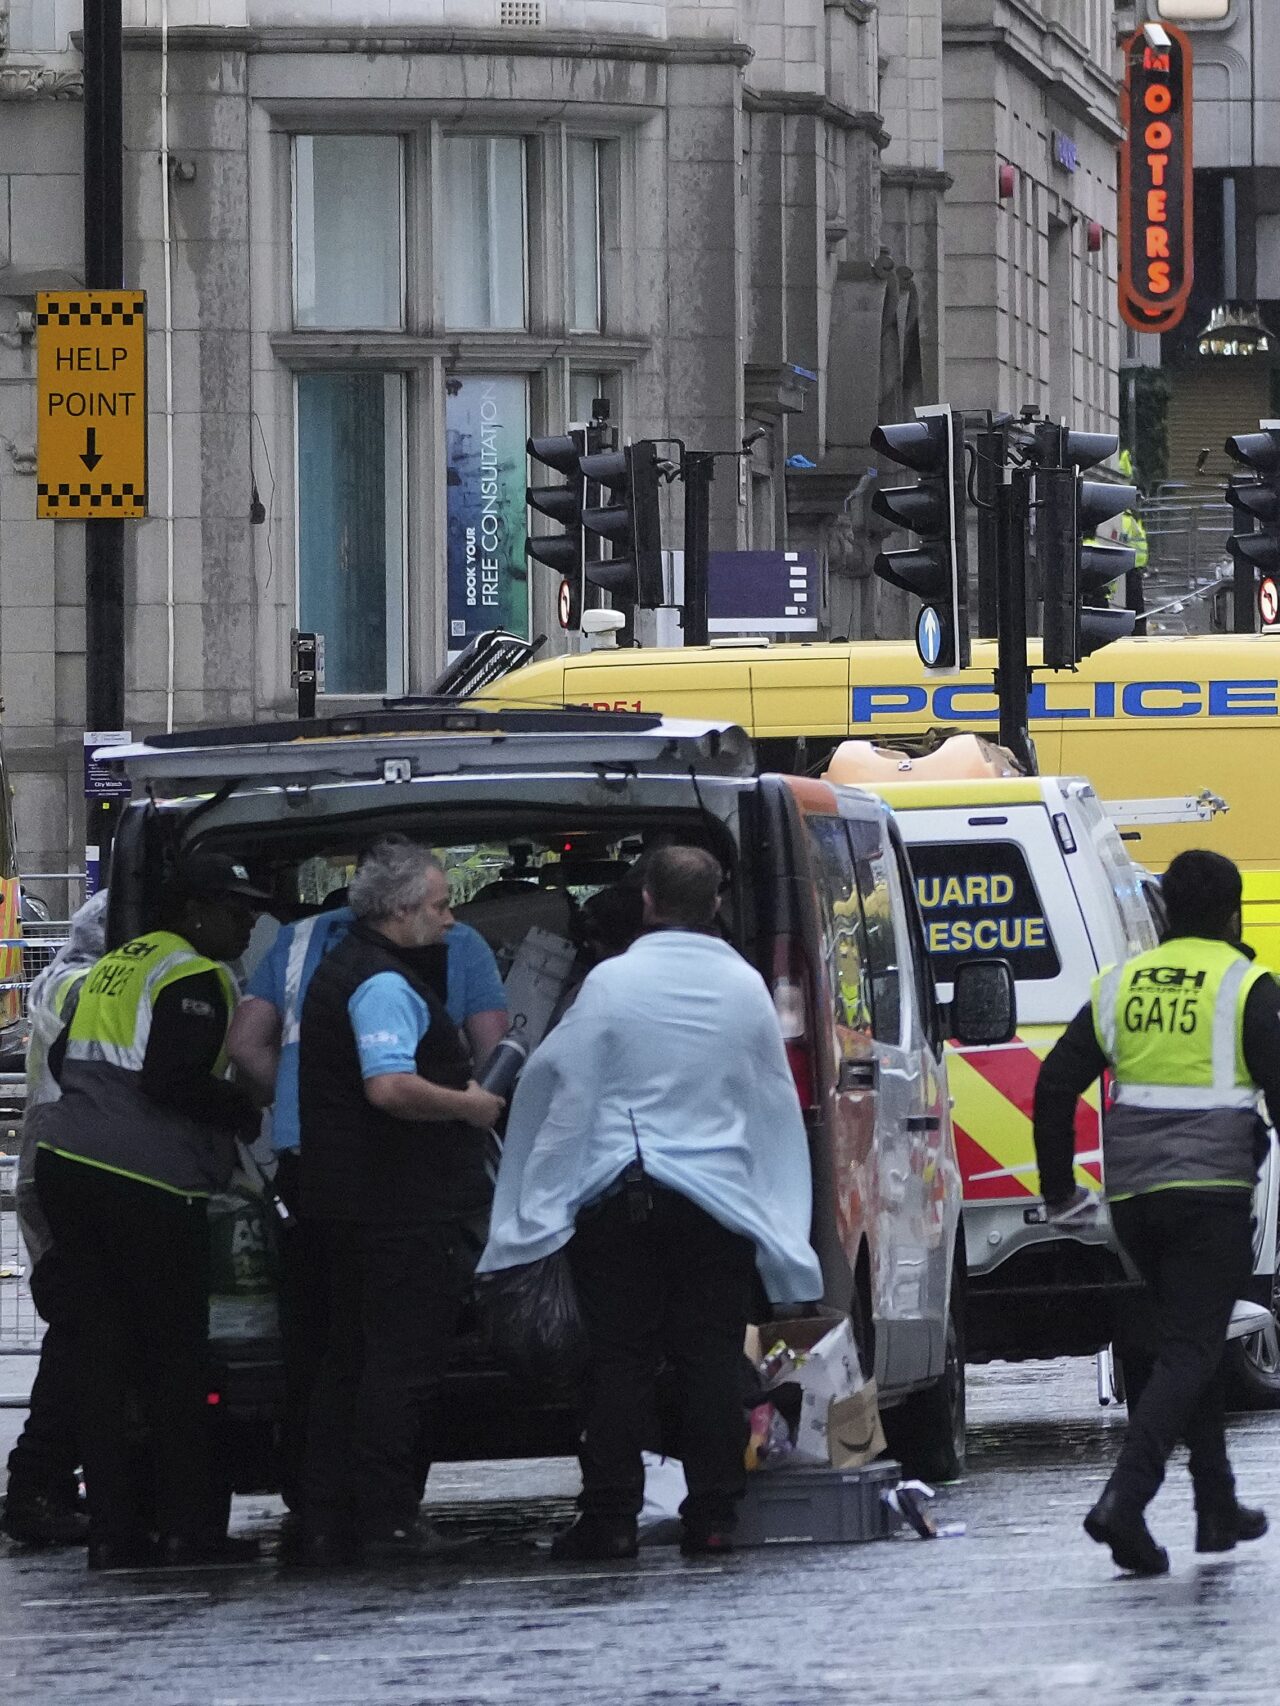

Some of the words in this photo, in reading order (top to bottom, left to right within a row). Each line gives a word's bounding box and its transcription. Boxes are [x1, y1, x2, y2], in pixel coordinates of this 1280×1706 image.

[56, 347, 127, 371] HELP
[49, 392, 136, 416] POINT
[480, 382, 499, 552] CONSULTATION
[467, 527, 476, 562] YOUR
[467, 565, 477, 606] BOOK
[482, 559, 499, 606] FREE
[852, 680, 1279, 722] POLICE
[1125, 996, 1198, 1035] GA15
